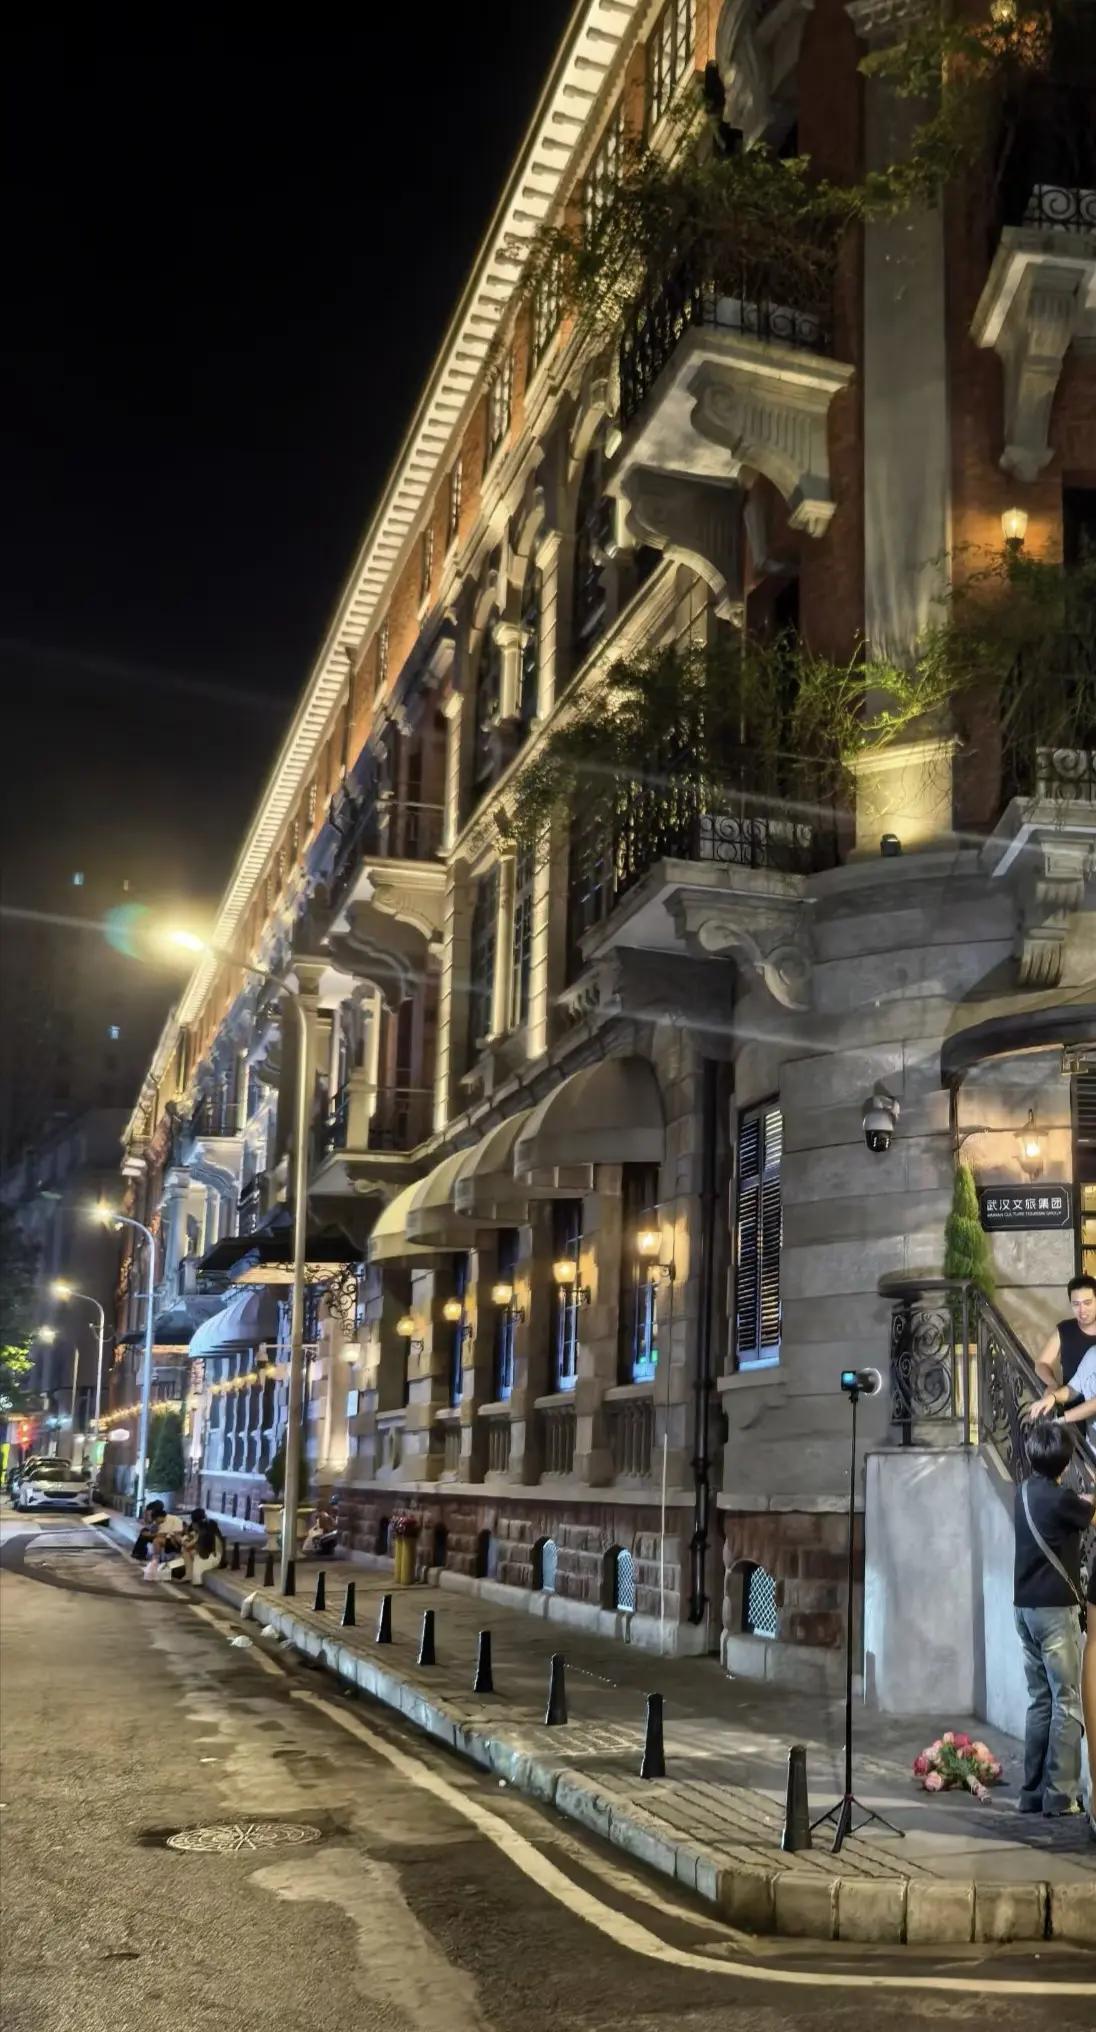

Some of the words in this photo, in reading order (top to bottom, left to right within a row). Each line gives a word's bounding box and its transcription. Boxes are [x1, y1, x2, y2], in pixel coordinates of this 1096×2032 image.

[987, 1198, 1062, 1211] 武汉文旅集团
